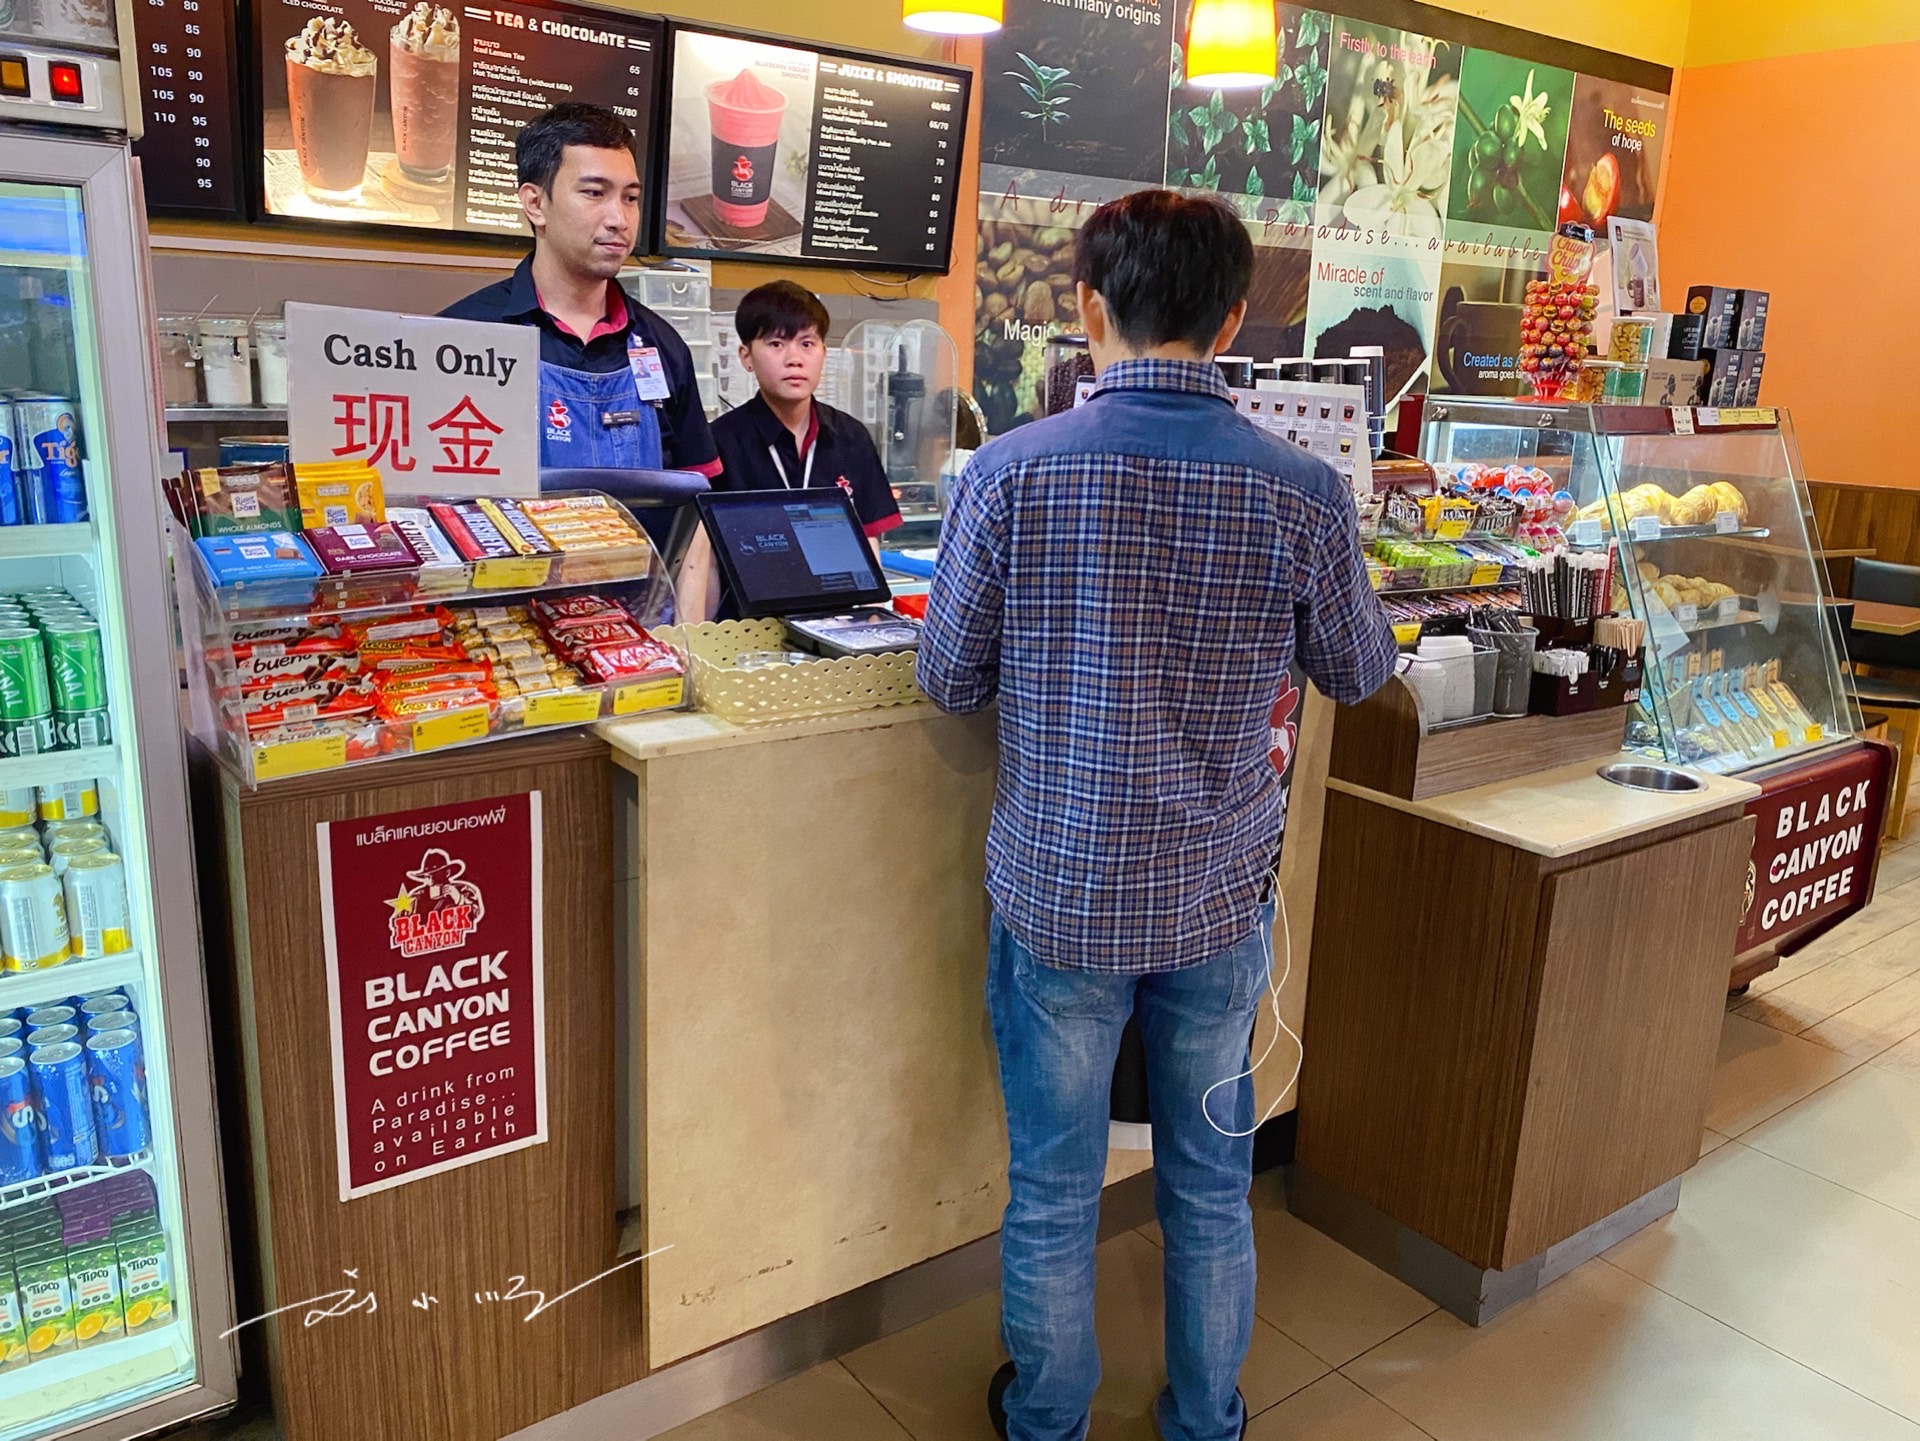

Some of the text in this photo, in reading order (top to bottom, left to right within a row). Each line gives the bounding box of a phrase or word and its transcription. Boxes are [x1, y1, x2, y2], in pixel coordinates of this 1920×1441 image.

[183, 1, 198, 12] 80
[301, 1, 344, 14] CHOCOLATE
[374, 5, 400, 15] FRAPPE
[1074, 0, 1112, 19] many
[1116, 4, 1161, 25] origins
[185, 25, 200, 35] 85
[494, 11, 625, 48] TEA & CHOCOLATE
[152, 43, 202, 58] 95 90
[1339, 31, 1437, 69] Firstly to the earth
[473, 45, 641, 75] Iced Lemon Tea 65
[150, 66, 203, 81] 105 90
[473, 69, 486, 77] Hot
[516, 76, 528, 84] Tea
[529, 78, 555, 89] (without
[628, 87, 639, 96] 65
[838, 63, 944, 91] JUICE & SMOOTHIE
[152, 89, 204, 104] 105 90
[472, 92, 501, 102] Hot/Iced
[527, 101, 546, 109] Green
[612, 106, 637, 117] 75/80
[153, 112, 207, 126] 110 95
[471, 113, 514, 126] Thai Iced Tea
[929, 120, 949, 130] 65/70
[1603, 109, 1656, 138] The seeds
[194, 137, 209, 147] 90
[470, 135, 497, 145] Tropical
[938, 141, 947, 149] 70
[1611, 133, 1642, 153] of hope
[196, 158, 210, 168] 90
[936, 158, 945, 166] 70
[197, 178, 212, 189] 95
[934, 176, 942, 184] 75
[1000, 180, 1020, 212] A
[1049, 185, 1101, 216] dri
[1428, 232, 1541, 261] available
[926, 243, 934, 251] 85
[1557, 237, 1590, 255] Chupa
[1552, 250, 1580, 267] Chup
[1317, 263, 1384, 285] Miracle of
[1354, 285, 1434, 302] scent and flavor
[1004, 319, 1056, 345] Magic
[324, 334, 517, 387] Cash Only
[1463, 352, 1513, 368] Created as
[1478, 370, 1513, 381] aroma goes
[332, 394, 504, 475] 现金
[547, 428, 571, 437] BLACK
[217, 521, 282, 533] WHOLE ALMONDS
[755, 533, 786, 541] BLACK
[759, 540, 788, 548] CANYON
[357, 551, 402, 560] CHOCOLATE
[233, 626, 292, 641] bueno
[253, 653, 312, 674] bueno
[52, 655, 86, 700] GINAL
[263, 683, 322, 700] bueno
[1776, 780, 1870, 839] BLACK
[356, 805, 506, 846] แบล็คแคนยอนคอฟฟี่
[1769, 824, 1863, 884] CANYON
[1761, 867, 1853, 930] COFFEE
[395, 906, 472, 943] BLACK
[406, 930, 462, 953] CANYON
[365, 951, 509, 1010] BLACK
[367, 989, 509, 1043] CANYON
[369, 1021, 510, 1077] COFFEE
[371, 1066, 514, 1114] A drink from
[373, 1092, 515, 1134] Paradise...
[374, 1104, 514, 1153] available
[375, 1122, 515, 1173] on Earth
